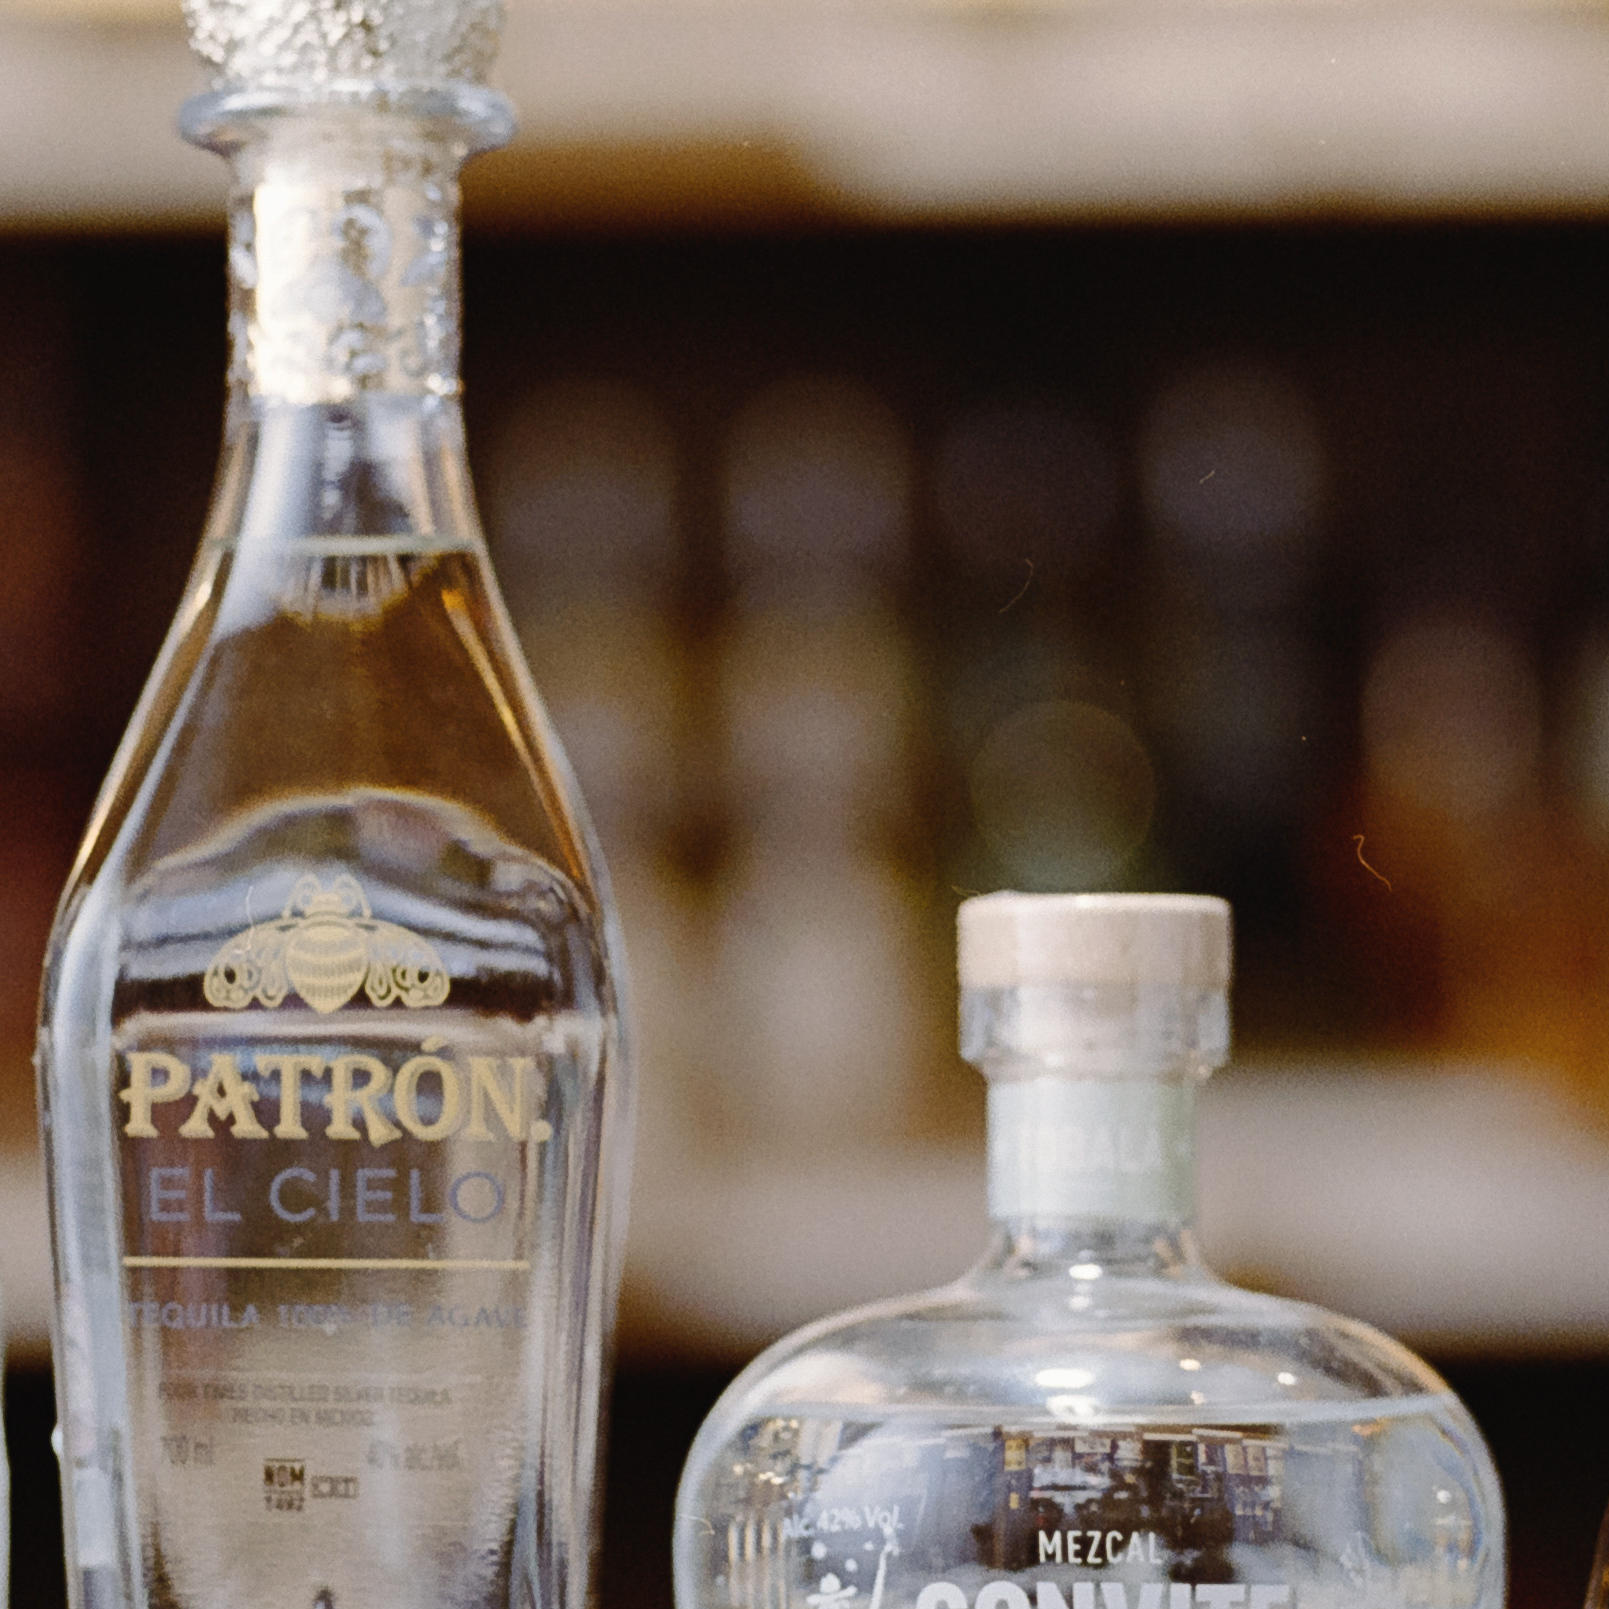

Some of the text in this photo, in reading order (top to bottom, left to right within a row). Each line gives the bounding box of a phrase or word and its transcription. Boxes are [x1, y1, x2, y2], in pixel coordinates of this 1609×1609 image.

[150, 1168, 506, 1224] EL CIELO
[130, 1300, 261, 1329] TEQUILA
[1037, 1529, 1164, 1566] MEZCAL
